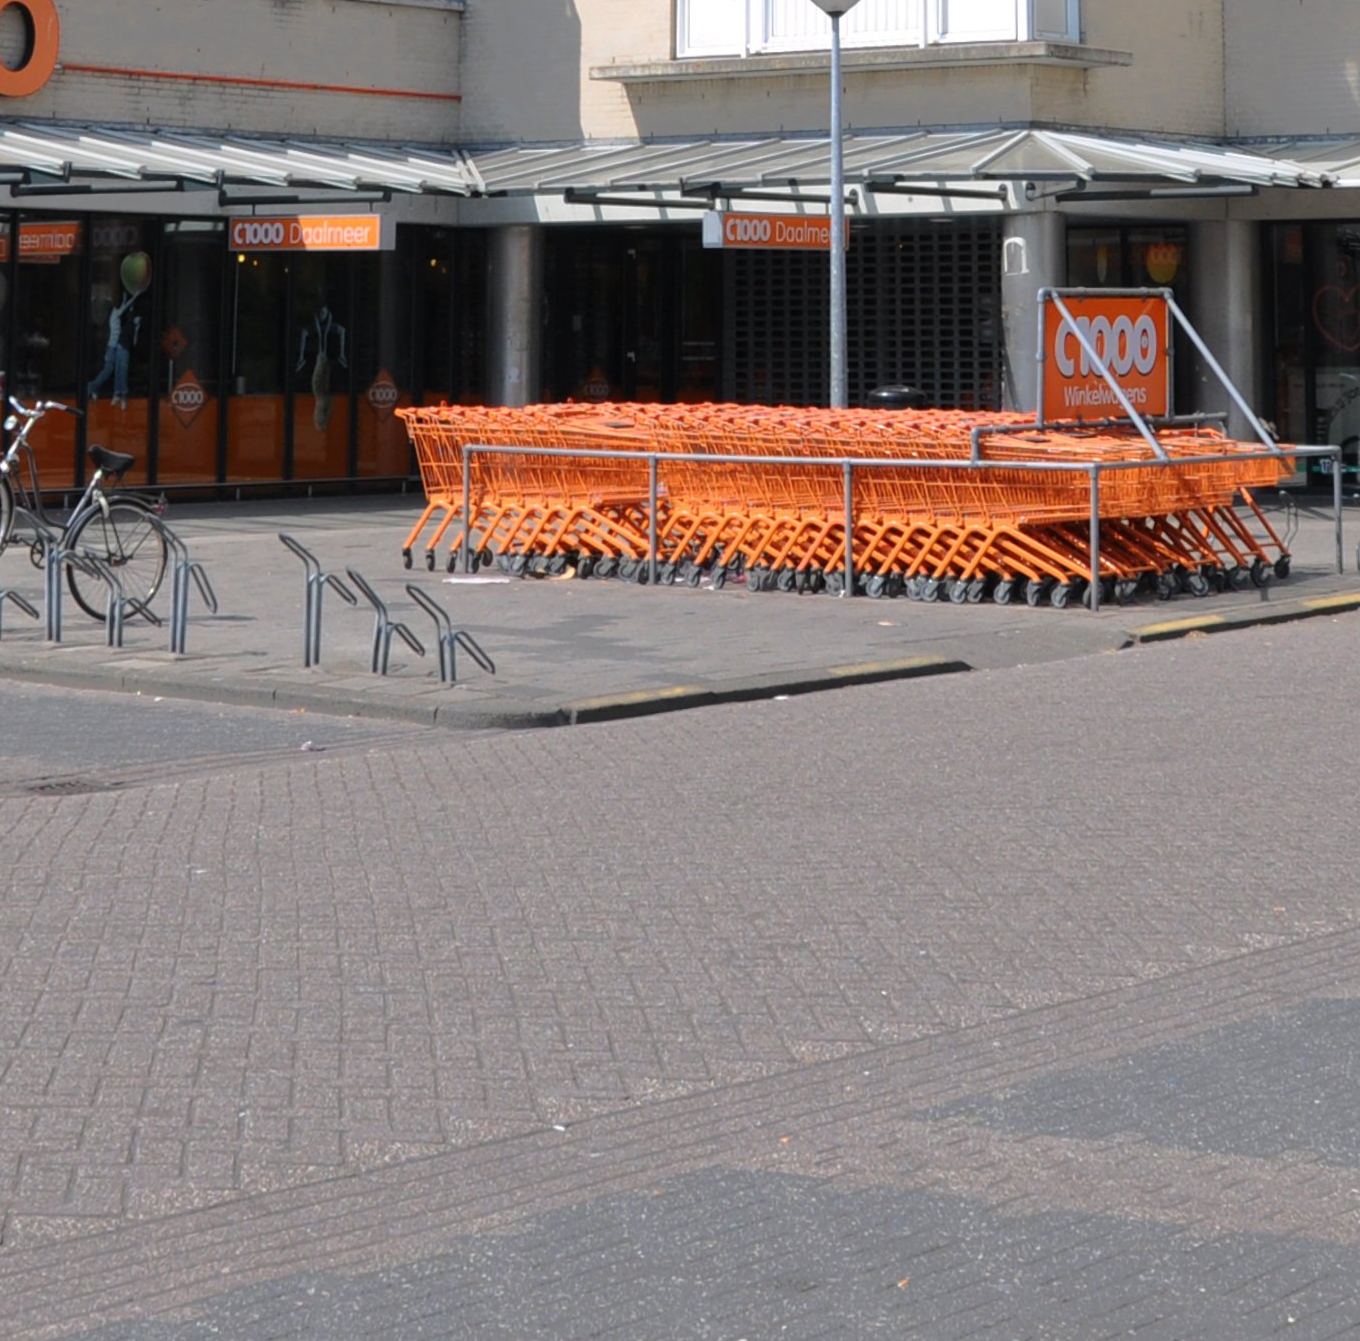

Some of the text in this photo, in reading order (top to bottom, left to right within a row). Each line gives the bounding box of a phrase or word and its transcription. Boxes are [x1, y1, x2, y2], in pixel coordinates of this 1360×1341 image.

[233, 220, 371, 245] C1000 Daalmeer
[726, 218, 831, 243] C1000 Daalme
[1055, 314, 1157, 377] C1000
[172, 390, 203, 404] C1000
